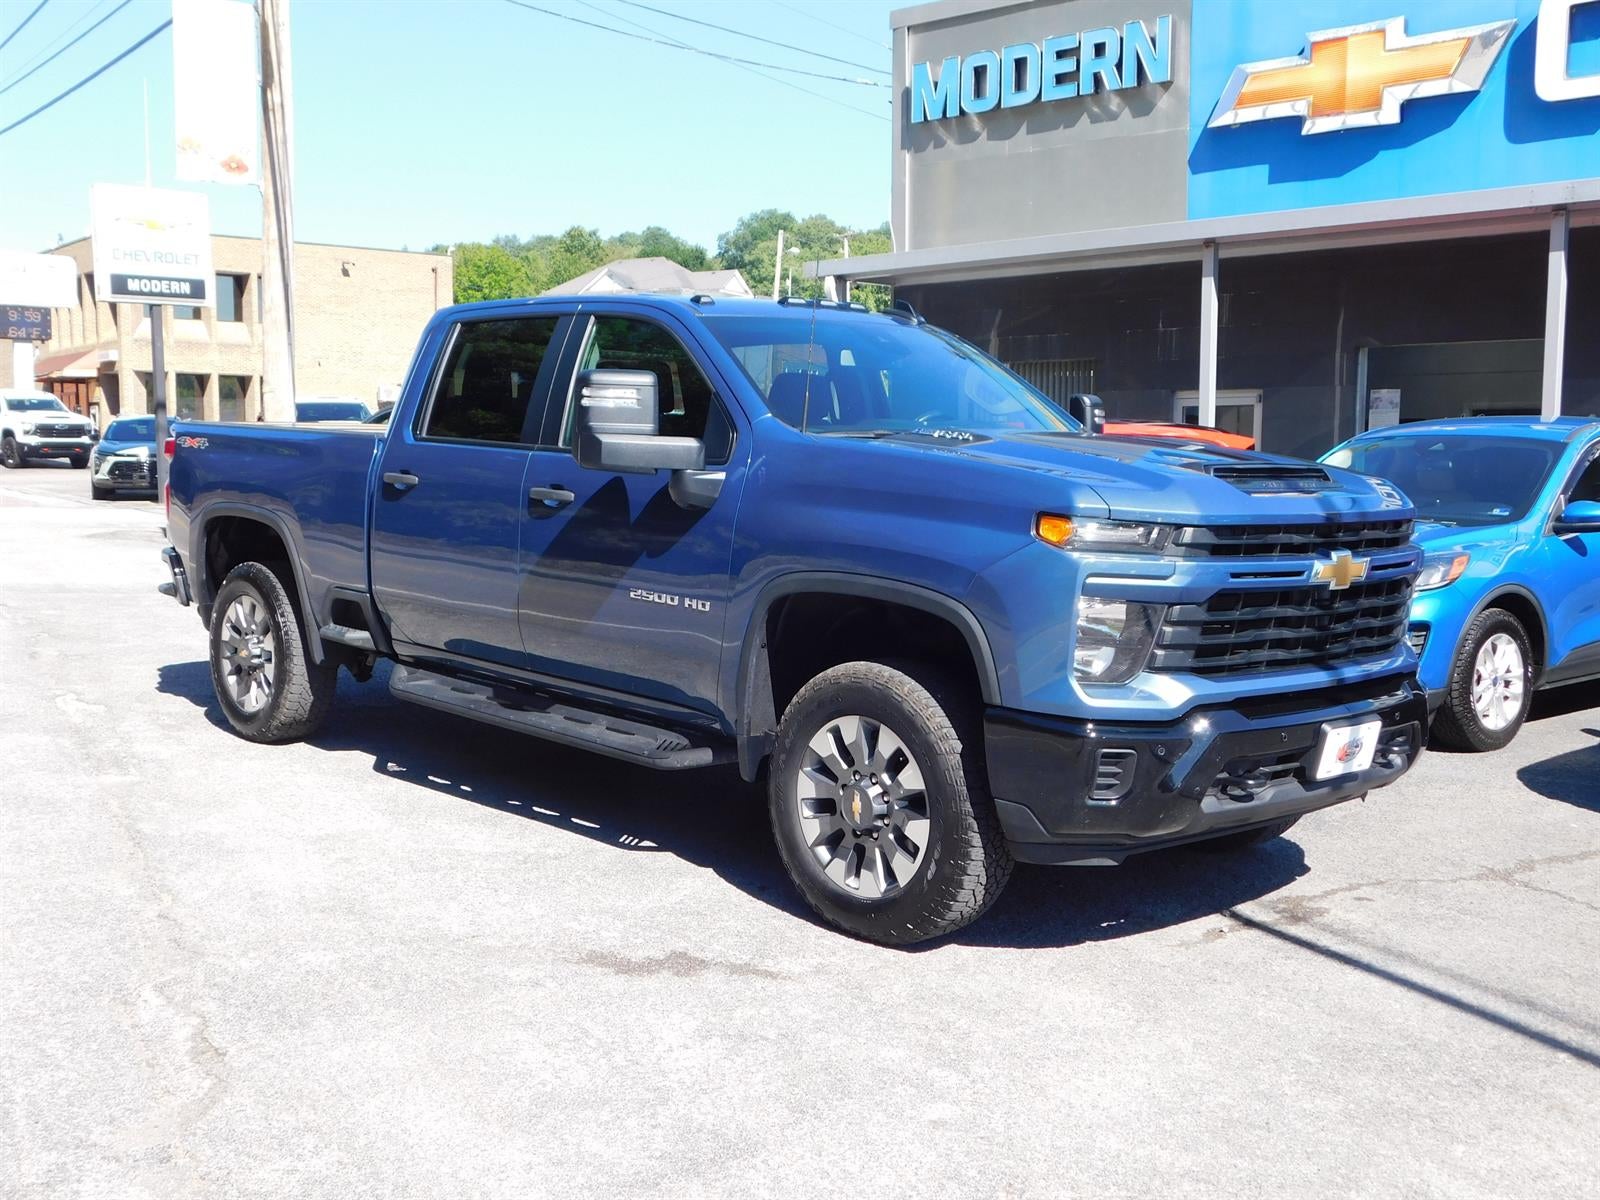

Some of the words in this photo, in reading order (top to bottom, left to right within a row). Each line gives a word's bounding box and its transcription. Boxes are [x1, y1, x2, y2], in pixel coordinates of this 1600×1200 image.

[911, 14, 1172, 124] MODERN
[112, 247, 201, 265] CHEVROLET
[127, 278, 191, 295] MODERN
[8, 309, 41, 323] 9:59
[629, 587, 679, 606] 2500
[684, 597, 711, 612] HD
